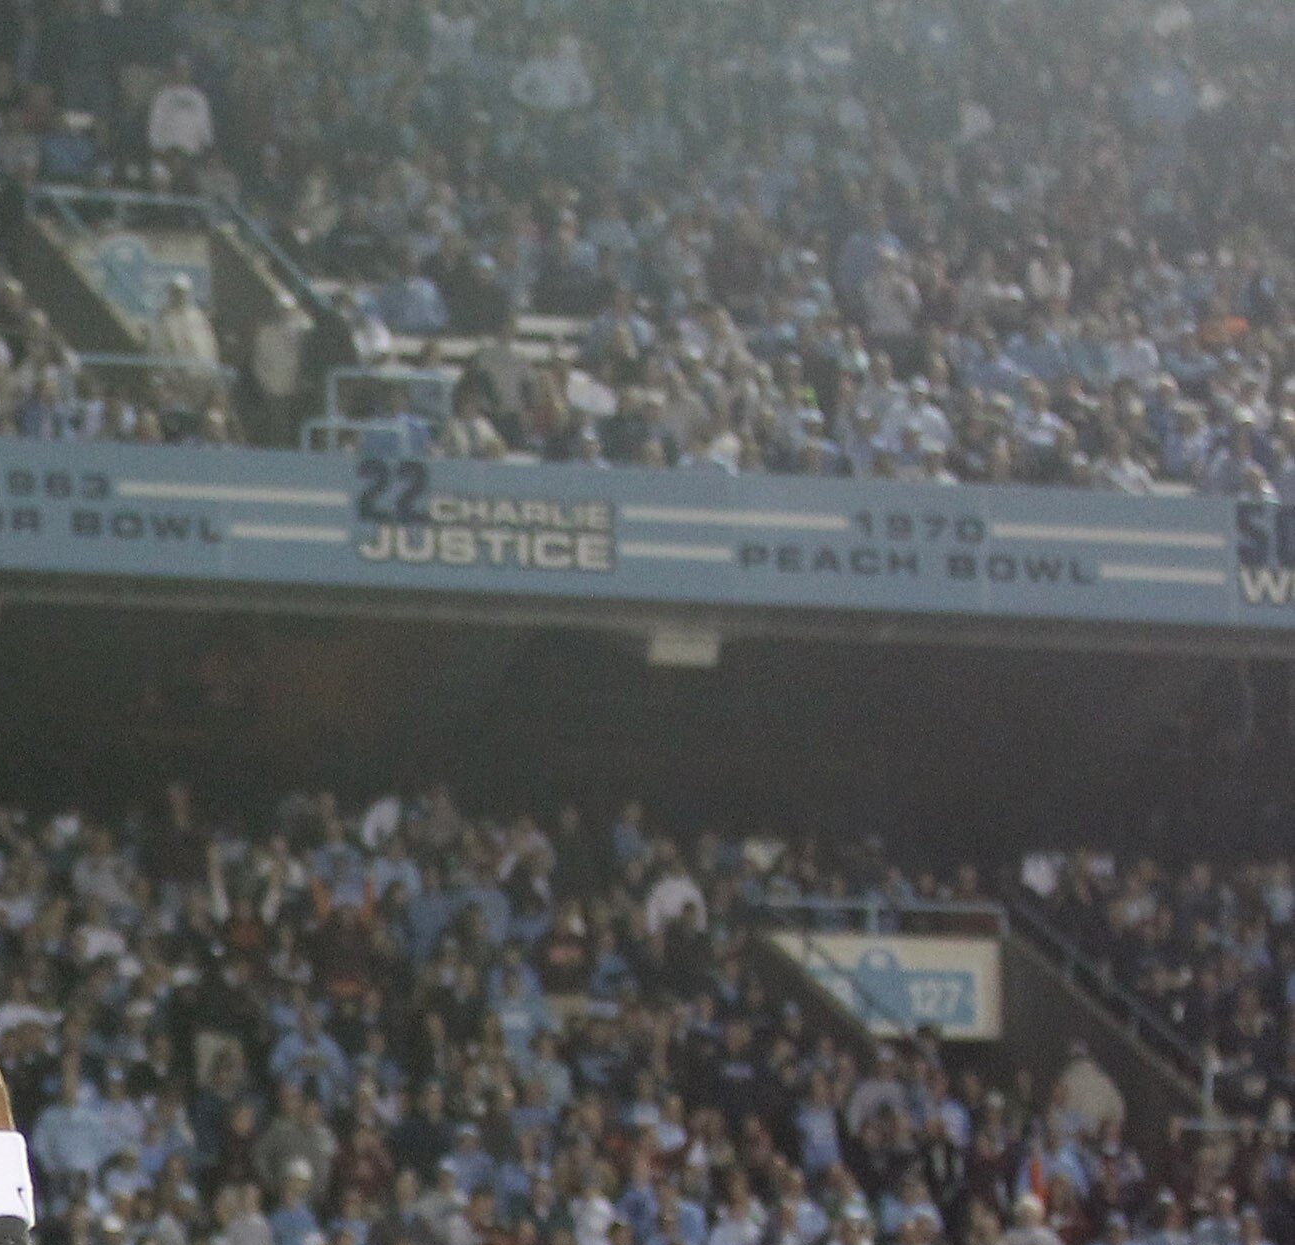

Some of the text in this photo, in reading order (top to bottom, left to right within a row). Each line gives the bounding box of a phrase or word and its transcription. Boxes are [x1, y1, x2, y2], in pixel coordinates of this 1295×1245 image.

[357, 458, 613, 532] 22 CHARLIE
[69, 509, 223, 545] BOWL
[358, 524, 614, 572] JUSTICE
[852, 509, 987, 545] 1970
[736, 543, 1098, 586] PEACH BOWL
